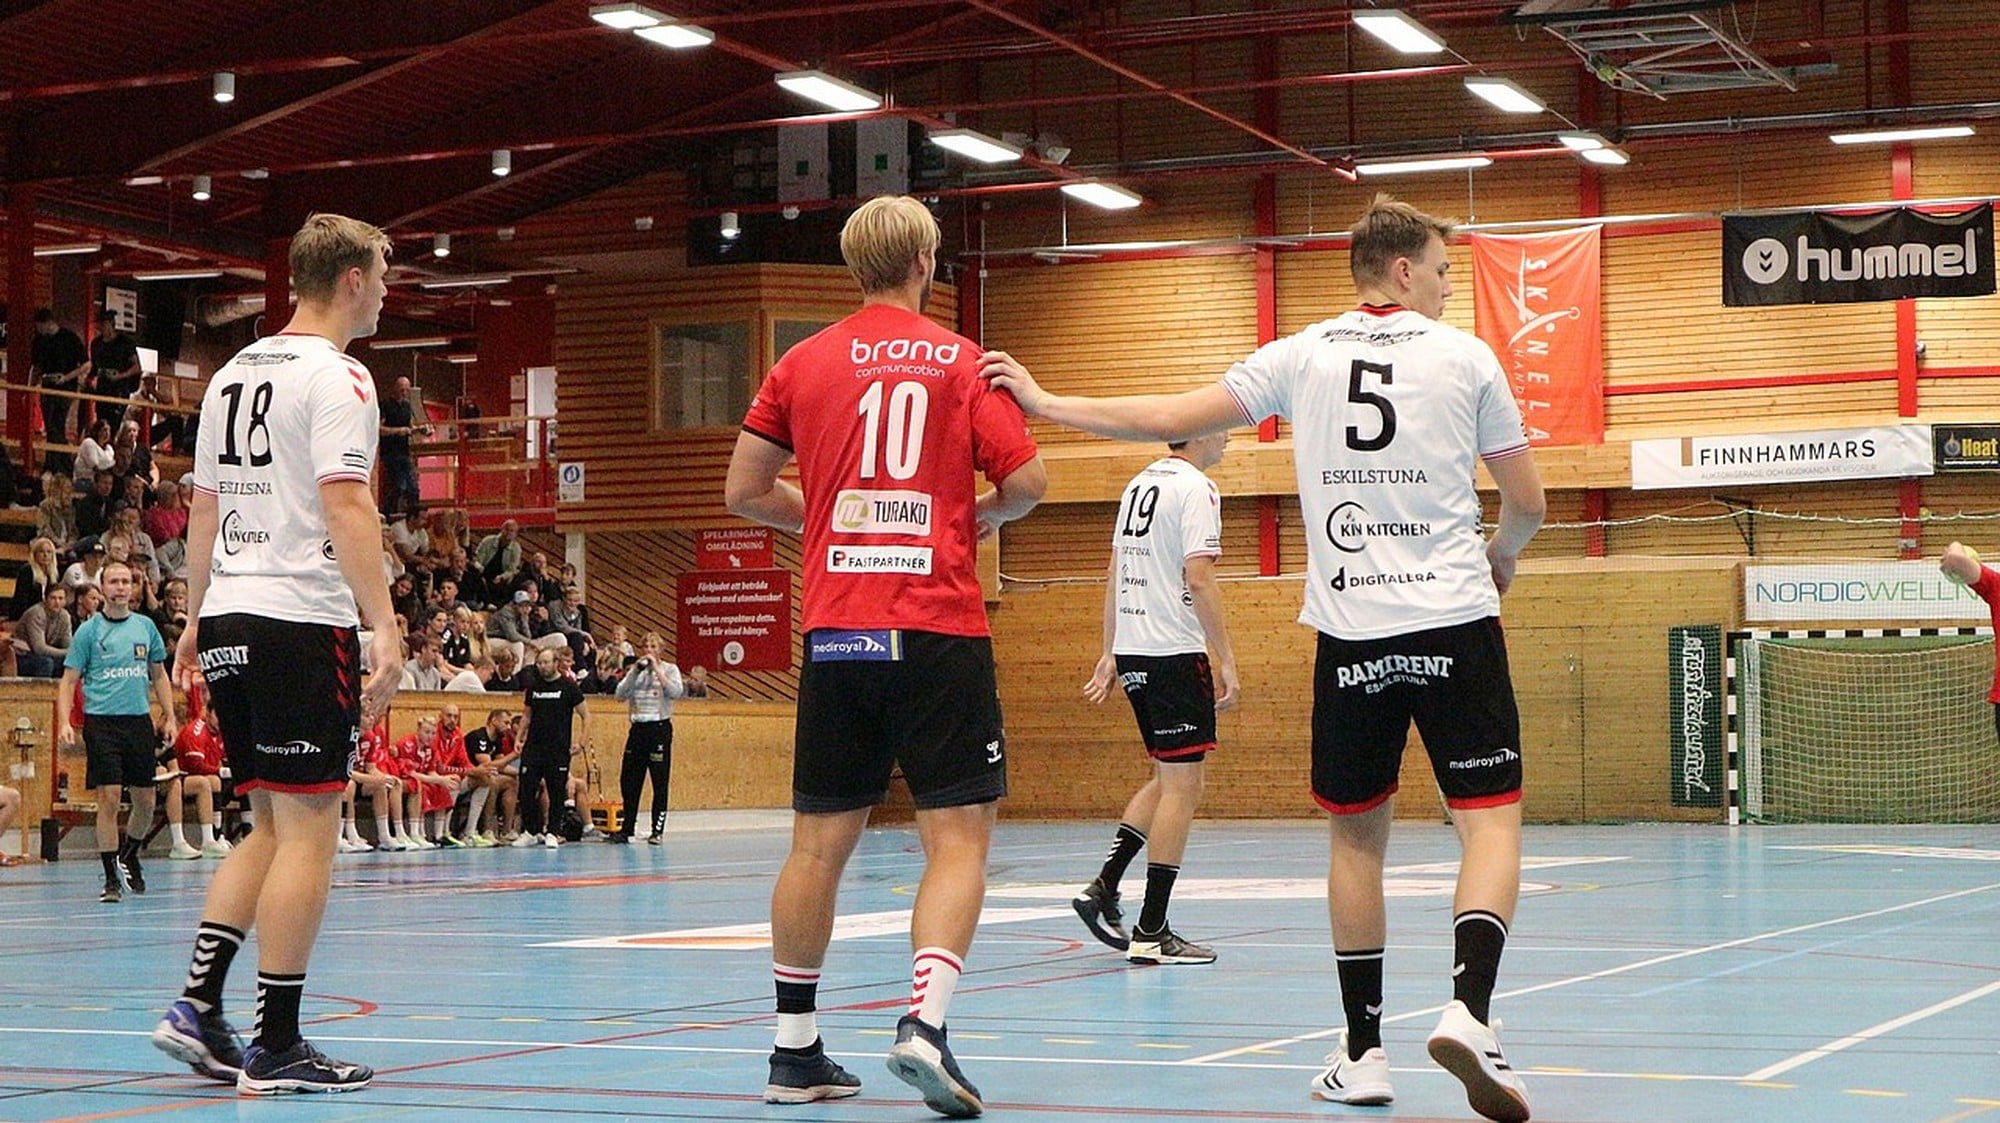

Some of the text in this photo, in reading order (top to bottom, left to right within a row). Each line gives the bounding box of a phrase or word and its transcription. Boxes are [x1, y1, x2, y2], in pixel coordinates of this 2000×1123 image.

[1797, 228, 1977, 282] hummel
[850, 338, 960, 365] brand
[855, 364, 945, 378] communication
[1345, 359, 1397, 451] 5
[218, 381, 273, 467] 18
[858, 380, 929, 481] 10
[1700, 439, 1876, 466] FINNHAMMARS
[1962, 438, 1999, 457] Heat
[1322, 469, 1428, 485] ESKILSTUNA
[874, 500, 928, 526] TURAKO
[1122, 484, 1160, 538] 19
[1366, 522, 1431, 537] KITCHEN
[848, 556, 926, 569] FASTPARTNER
[1349, 571, 1437, 587] DIGITALERA
[1337, 654, 1453, 688] RAMIRENT
[1449, 753, 1504, 769] mediroyal
